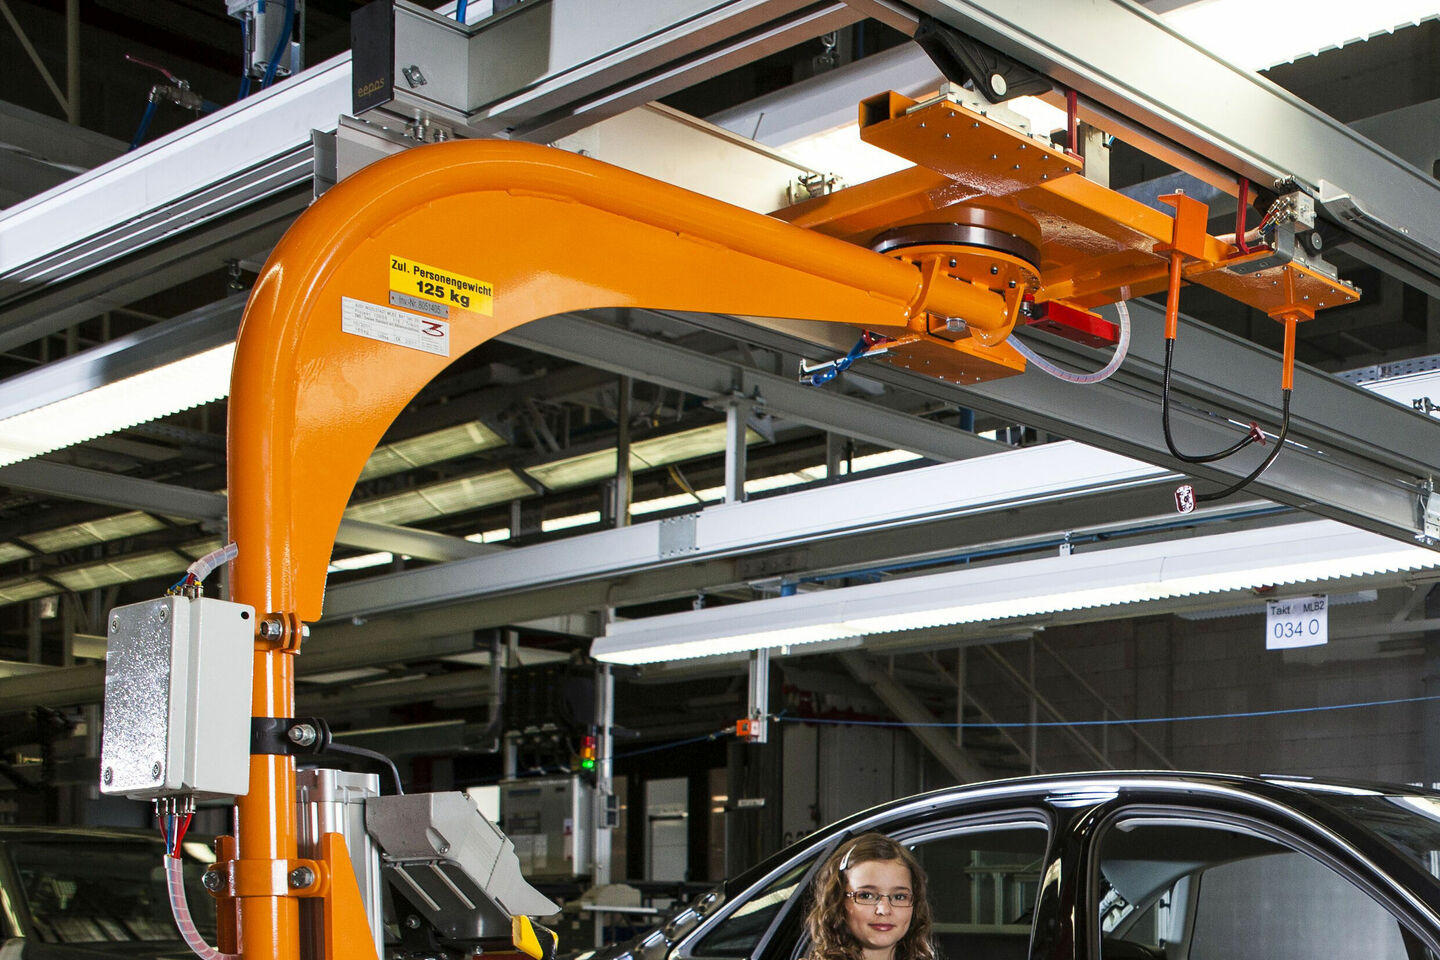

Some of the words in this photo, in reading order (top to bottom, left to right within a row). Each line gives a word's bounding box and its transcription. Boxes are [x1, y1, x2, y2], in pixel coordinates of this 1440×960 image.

[391, 259, 410, 273] Zul.
[413, 265, 492, 296] Personengewicht
[416, 280, 445, 298] 125
[450, 289, 470, 308] kg
[1271, 605, 1290, 615] Takt
[1303, 601, 1325, 612] MLB2
[1274, 621, 1303, 638] 034
